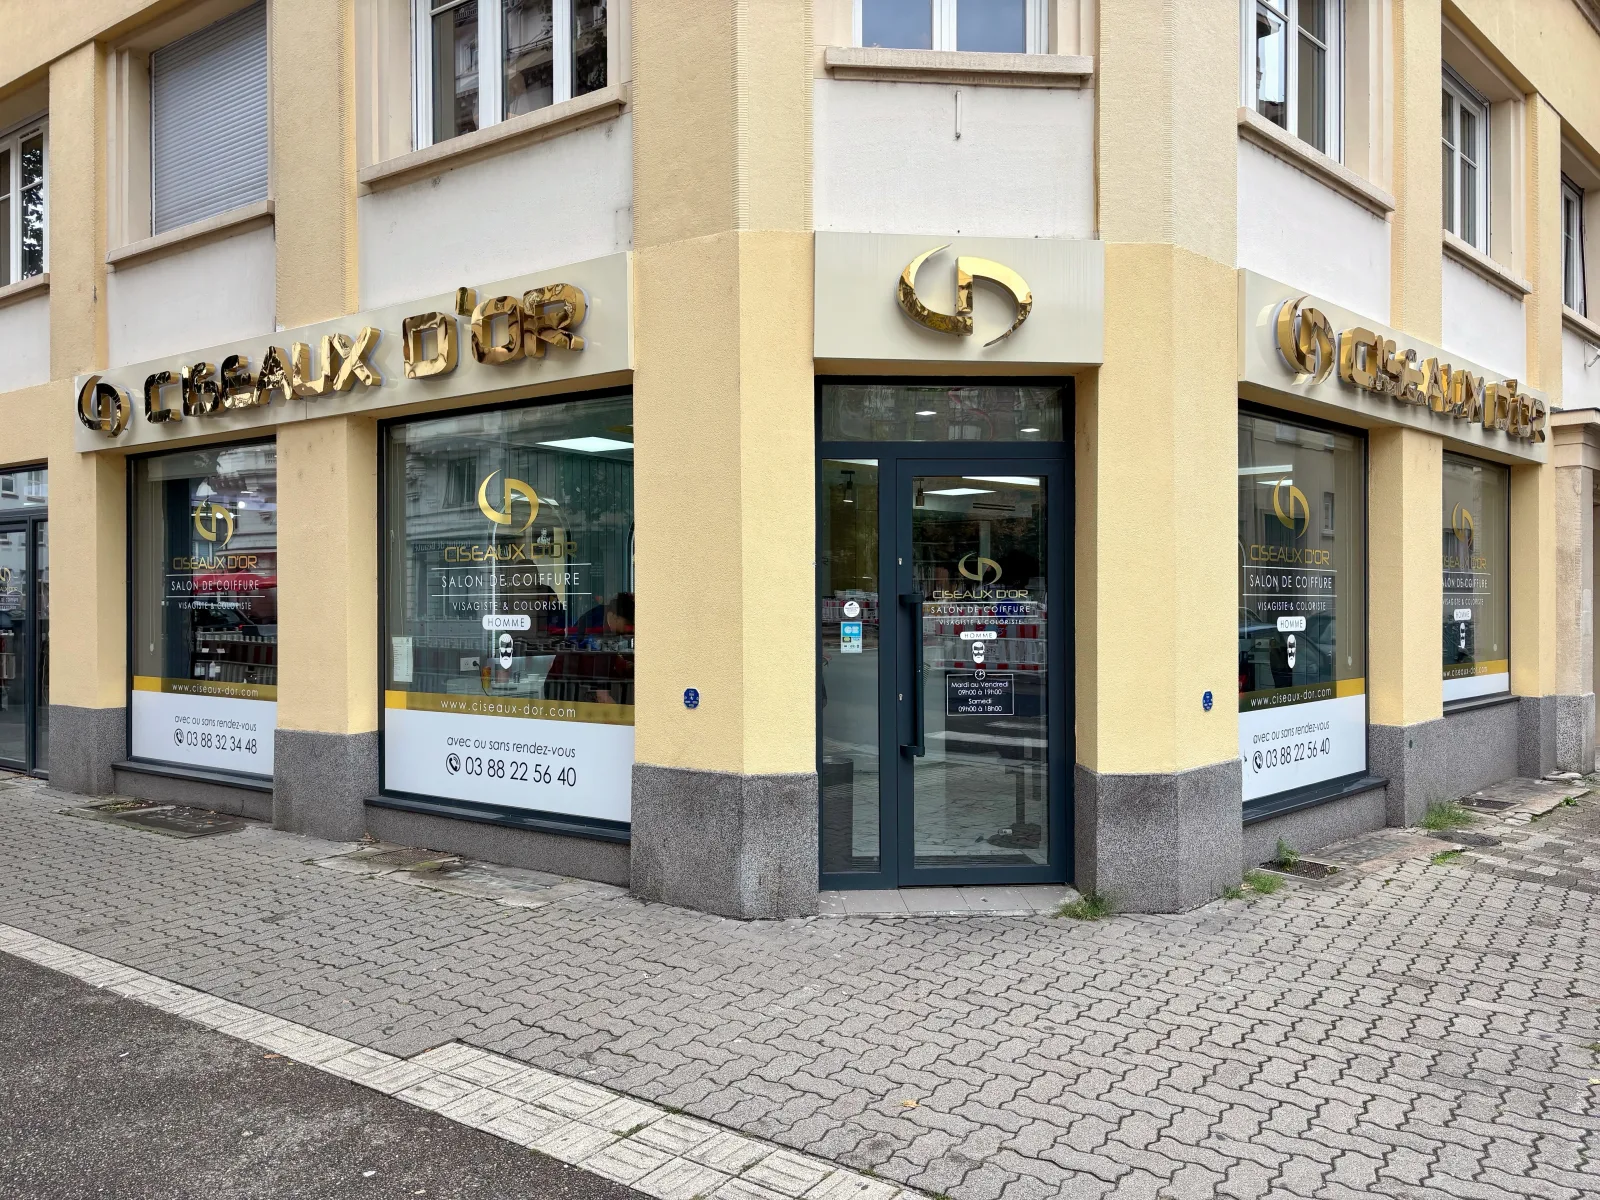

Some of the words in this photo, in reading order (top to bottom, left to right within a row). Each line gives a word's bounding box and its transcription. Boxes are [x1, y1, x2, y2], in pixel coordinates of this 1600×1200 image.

[144, 326, 384, 424] CISEAUX
[402, 282, 588, 380] D'OR
[444, 544, 526, 562] CISEAUX
[530, 541, 578, 558] D'OR
[1250, 544, 1302, 563] CISEAUX
[1304, 548, 1330, 566] D'OR
[172, 556, 225, 570] CISEAUX
[227, 556, 258, 569] D'OR
[171, 580, 199, 591] SALON
[202, 580, 212, 590] DE
[216, 580, 260, 590] COIFFURE
[442, 574, 484, 588] SALON
[490, 574, 506, 587] DE
[512, 572, 580, 586] COIFFURE
[1250, 574, 1278, 588] SALON
[1282, 576, 1292, 588] DE
[1296, 576, 1332, 588] COIFFURE
[932, 590, 993, 599] CISEAUX
[996, 589, 1028, 599] D'OR
[178, 602, 208, 610] VISAGISTE
[217, 602, 252, 610] COLORISTE
[452, 601, 498, 612] VISAGISTE
[502, 601, 509, 610] &
[514, 600, 568, 610] COLORISTE
[930, 606, 963, 614] SALON
[1258, 602, 1288, 610] VISAGISTE
[1290, 602, 1294, 610] &
[1296, 602, 1326, 610] COLORISTE
[487, 618, 525, 628] HOMME
[1280, 620, 1303, 628] HOMME
[172, 684, 259, 698] www.ciseaux-dor.com
[1250, 688, 1332, 707] www.ciseaux-dor.com
[440, 699, 576, 718] www.ciseaux-dor.com
[174, 715, 191, 724] avec
[192, 717, 200, 726] ou
[202, 718, 216, 728] sans
[216, 719, 257, 732] rendez-vous
[1252, 732, 1270, 744] avec
[1272, 730, 1280, 740] ou
[1280, 727, 1294, 739] sans
[1294, 720, 1330, 736] rendez-vous
[186, 730, 198, 746] 03
[200, 732, 212, 748] 88
[215, 734, 227, 750] 32
[230, 736, 242, 752] 34
[244, 738, 258, 754] 48
[446, 736, 471, 748] avec
[474, 739, 486, 749] ou
[488, 740, 510, 752] sans
[512, 741, 576, 758] rendez-vous
[1266, 748, 1278, 768] 03
[1280, 746, 1292, 765] 88
[1294, 742, 1304, 762] 22
[1307, 740, 1318, 758] 56
[1320, 738, 1330, 755] 40
[466, 756, 483, 776] 03
[488, 758, 505, 778] 88
[510, 761, 528, 782] 22
[533, 764, 552, 784] 56
[557, 766, 577, 787] 40
